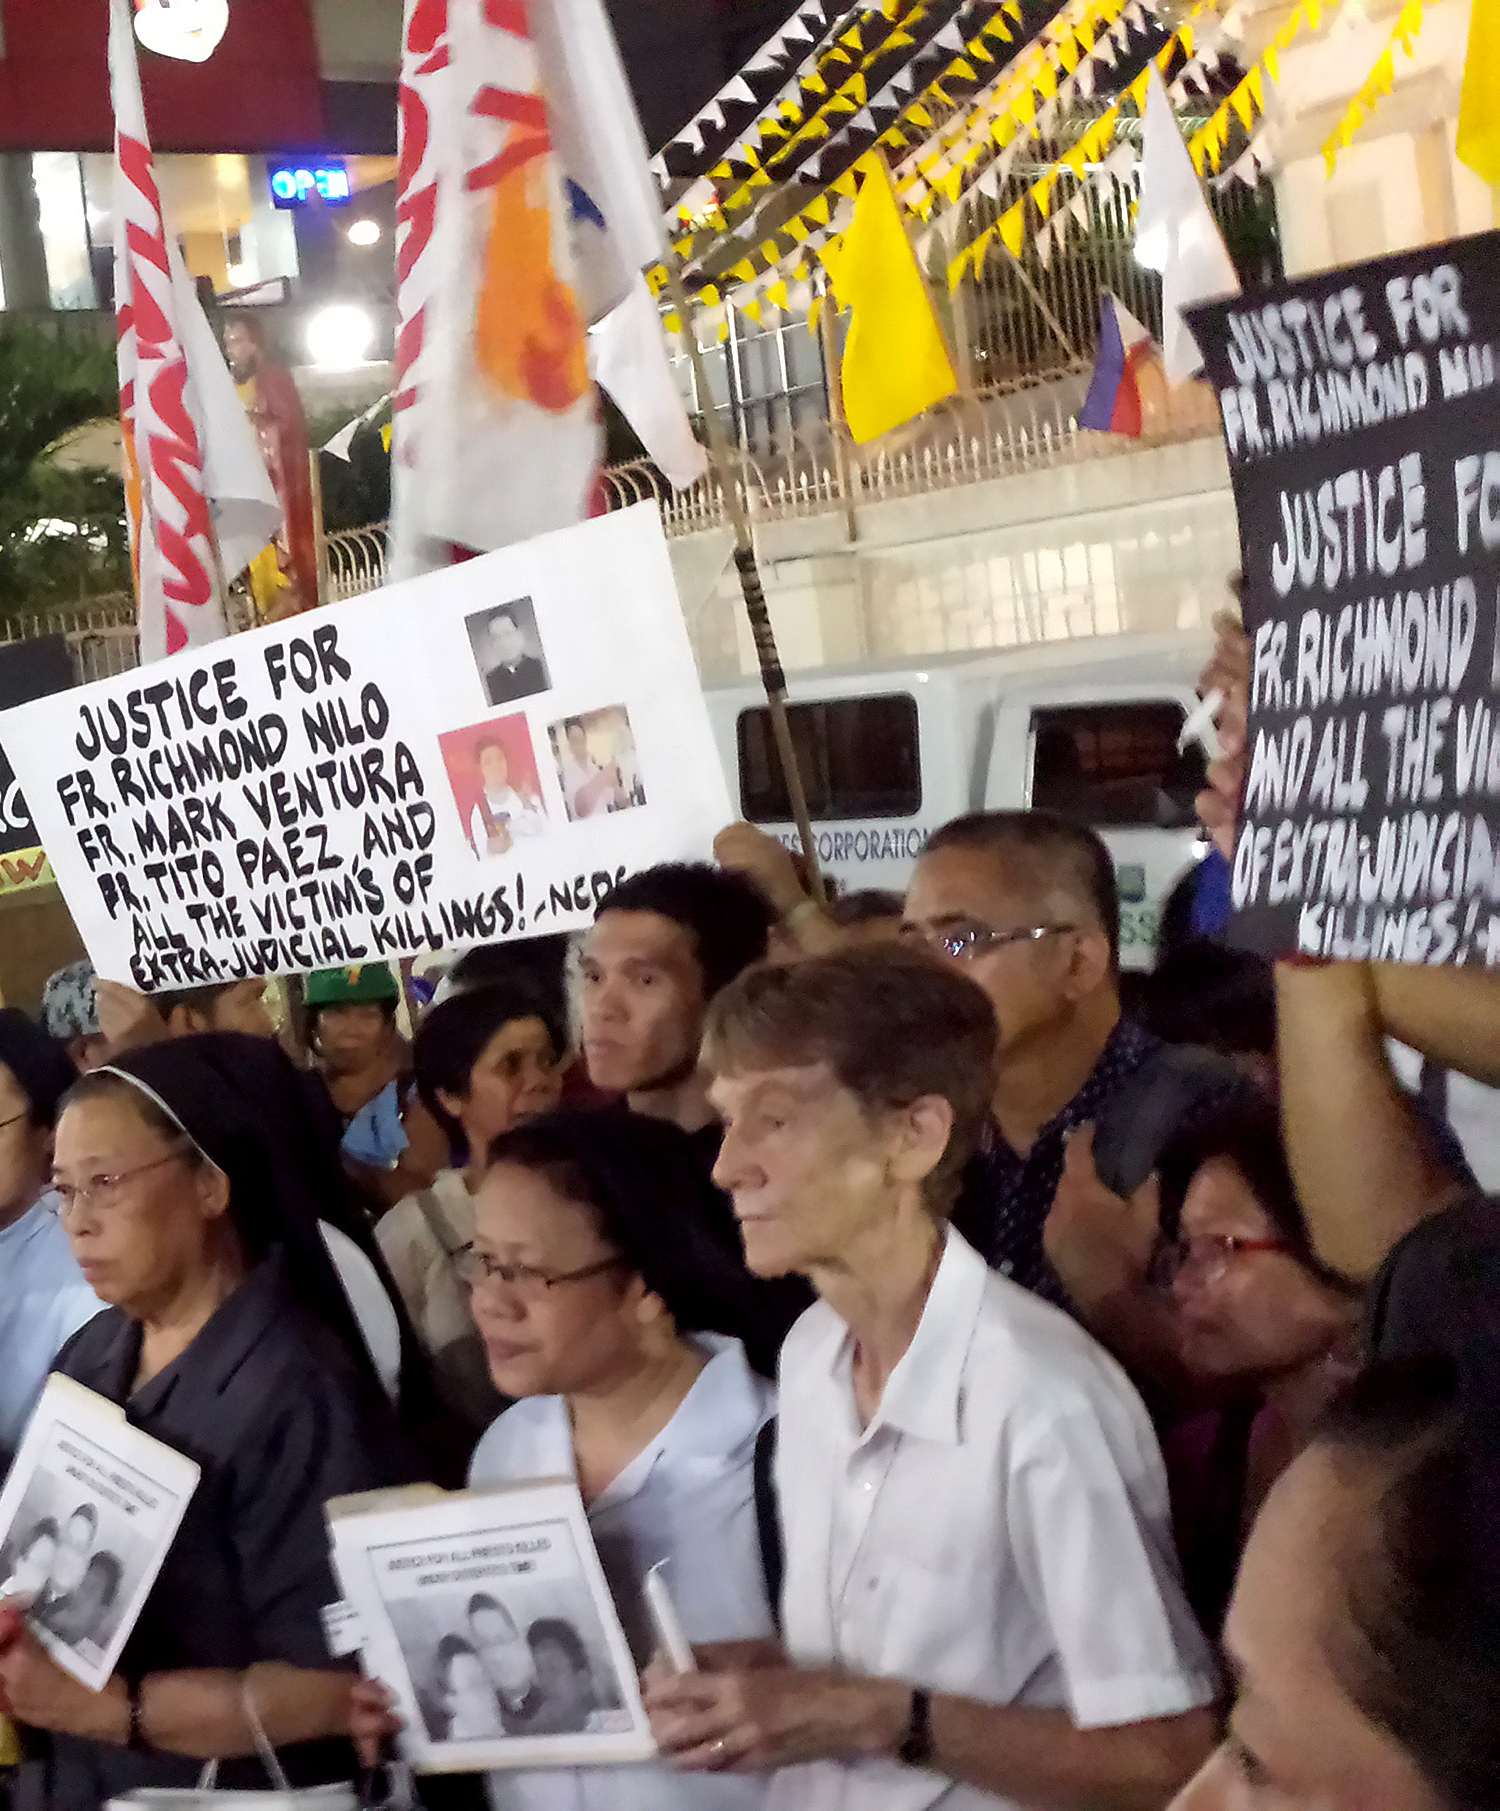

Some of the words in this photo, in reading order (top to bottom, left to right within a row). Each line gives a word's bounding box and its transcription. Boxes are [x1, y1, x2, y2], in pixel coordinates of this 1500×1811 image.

[271, 169, 350, 201] OPEN
[1227, 287, 1379, 381] JUSTICE
[1385, 264, 1471, 346] FOR
[1271, 451, 1428, 598] JUSTICE
[75, 658, 248, 761] JUSTICE
[264, 624, 352, 700] FOR
[1295, 575, 1478, 711] RICHMOND
[111, 713, 288, 807] RICHMOND
[302, 682, 390, 755] NILO
[132, 791, 238, 858] MARK
[243, 741, 425, 831] VENTURA
[1244, 715, 1313, 818] AND
[1309, 710, 1370, 812] ALL
[1382, 697, 1453, 805] THE
[132, 913, 187, 954] ALL
[186, 895, 247, 942] THE
[392, 853, 435, 906] OF
[143, 849, 225, 905] TITO
[364, 801, 436, 860] AND
[1231, 819, 1272, 911] OF
[129, 924, 368, 992] EXTRA-JUDICIAL
[370, 872, 527, 955] KILLINGS!
[1297, 895, 1481, 967] KILLINGS!
